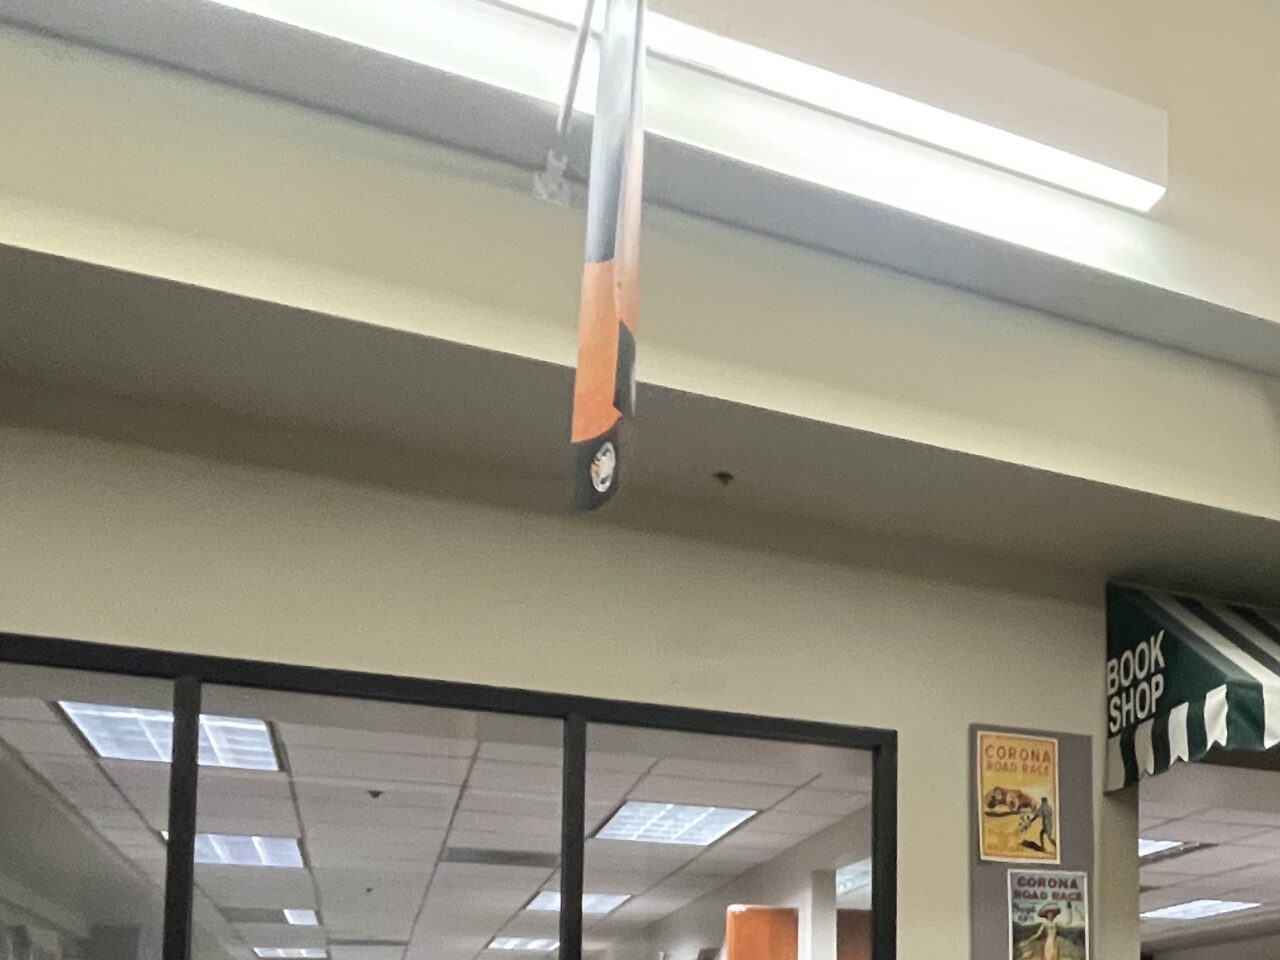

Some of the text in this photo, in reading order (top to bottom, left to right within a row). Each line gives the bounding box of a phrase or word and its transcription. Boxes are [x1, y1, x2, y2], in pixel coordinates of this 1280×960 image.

[1107, 629, 1166, 697] BOOK
[1108, 673, 1165, 733] SHOP
[985, 744, 1051, 763] CORONA
[986, 760, 1050, 777] ROAD RACE
[1017, 875, 1079, 890] CORONA
[1014, 889, 1083, 902] ROAD RACE
